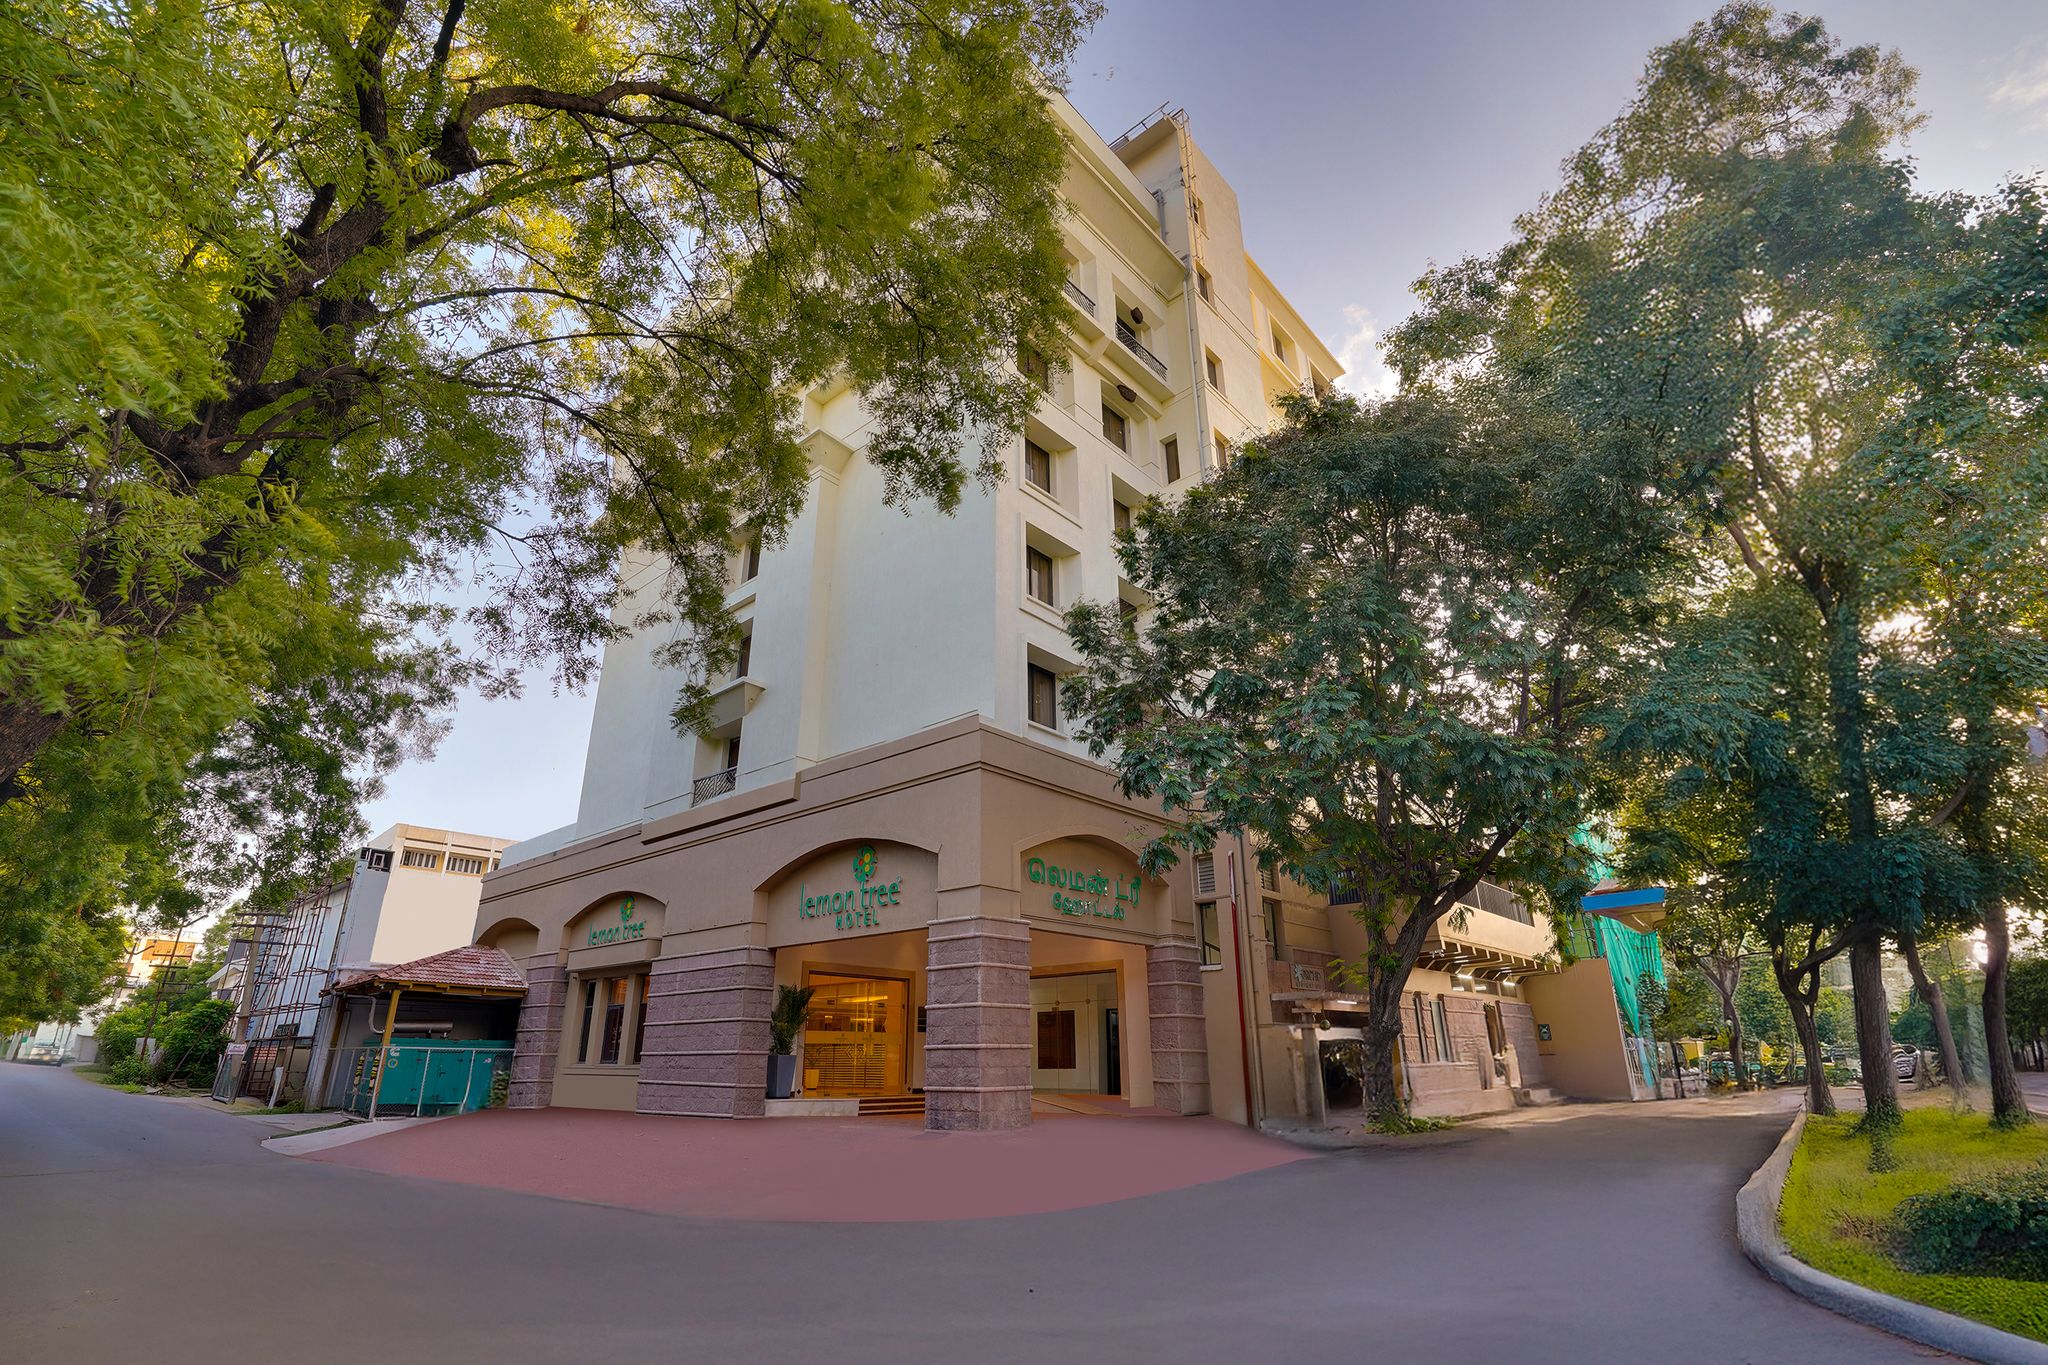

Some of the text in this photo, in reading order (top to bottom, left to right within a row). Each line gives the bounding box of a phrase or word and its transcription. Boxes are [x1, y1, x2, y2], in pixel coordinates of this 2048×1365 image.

[799, 880, 900, 918] lemon tree
[835, 909, 879, 930] HOTEL
[587, 921, 645, 945] lemon tree
